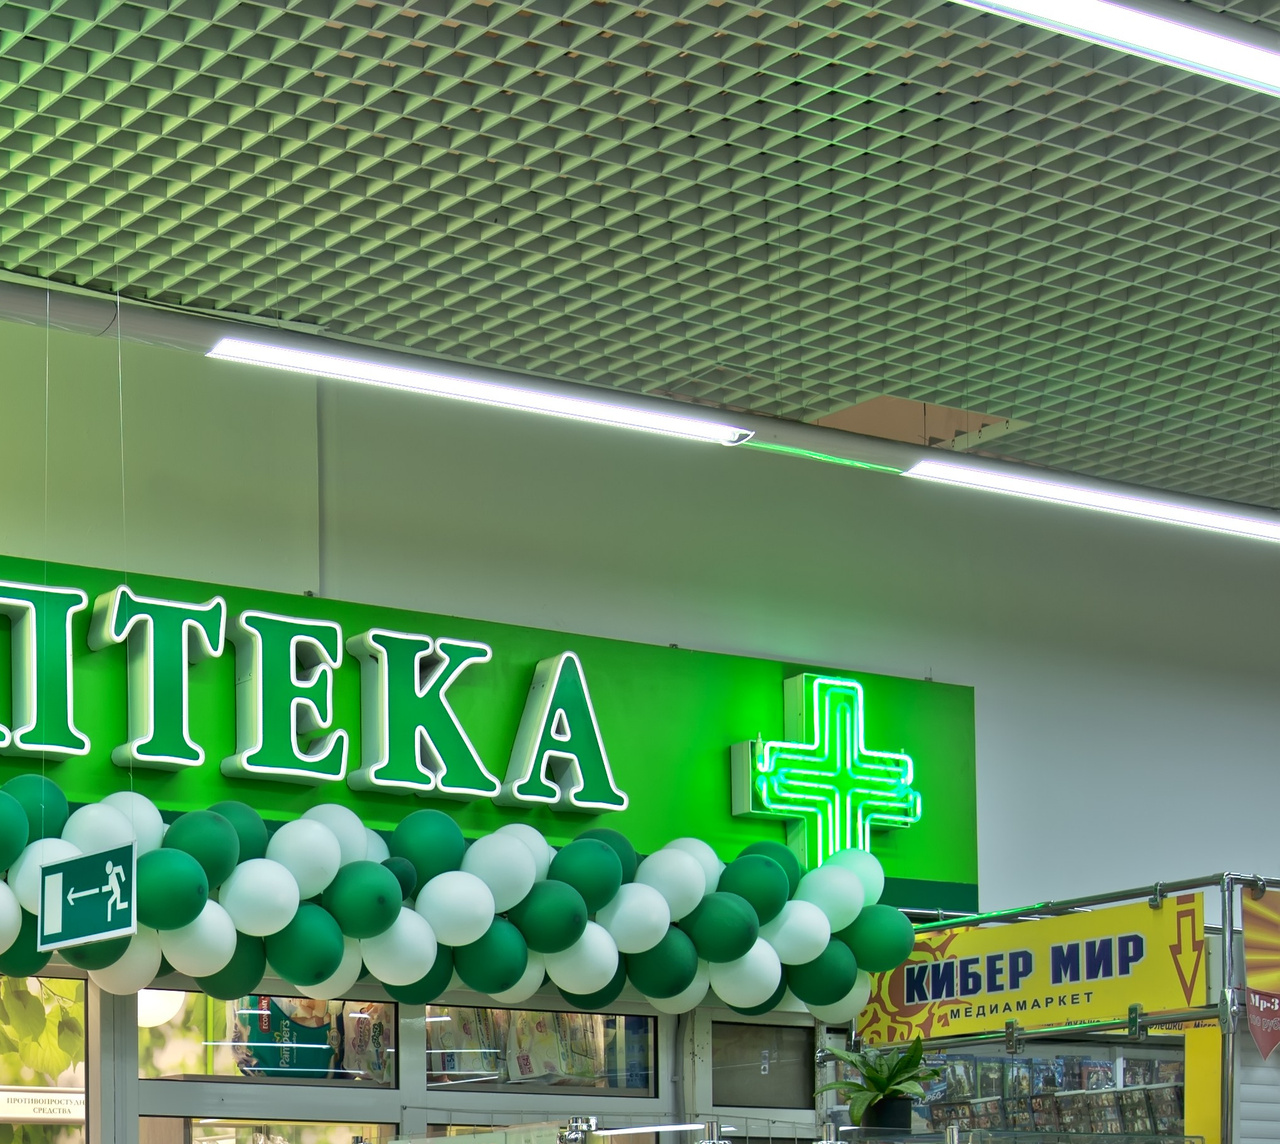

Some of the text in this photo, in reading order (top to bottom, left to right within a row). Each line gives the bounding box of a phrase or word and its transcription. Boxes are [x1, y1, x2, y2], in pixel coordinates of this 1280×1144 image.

[905, 933, 1145, 1005] КИБЕР МИР
[950, 991, 1093, 1019] МЕДИАМАРКЕТ
